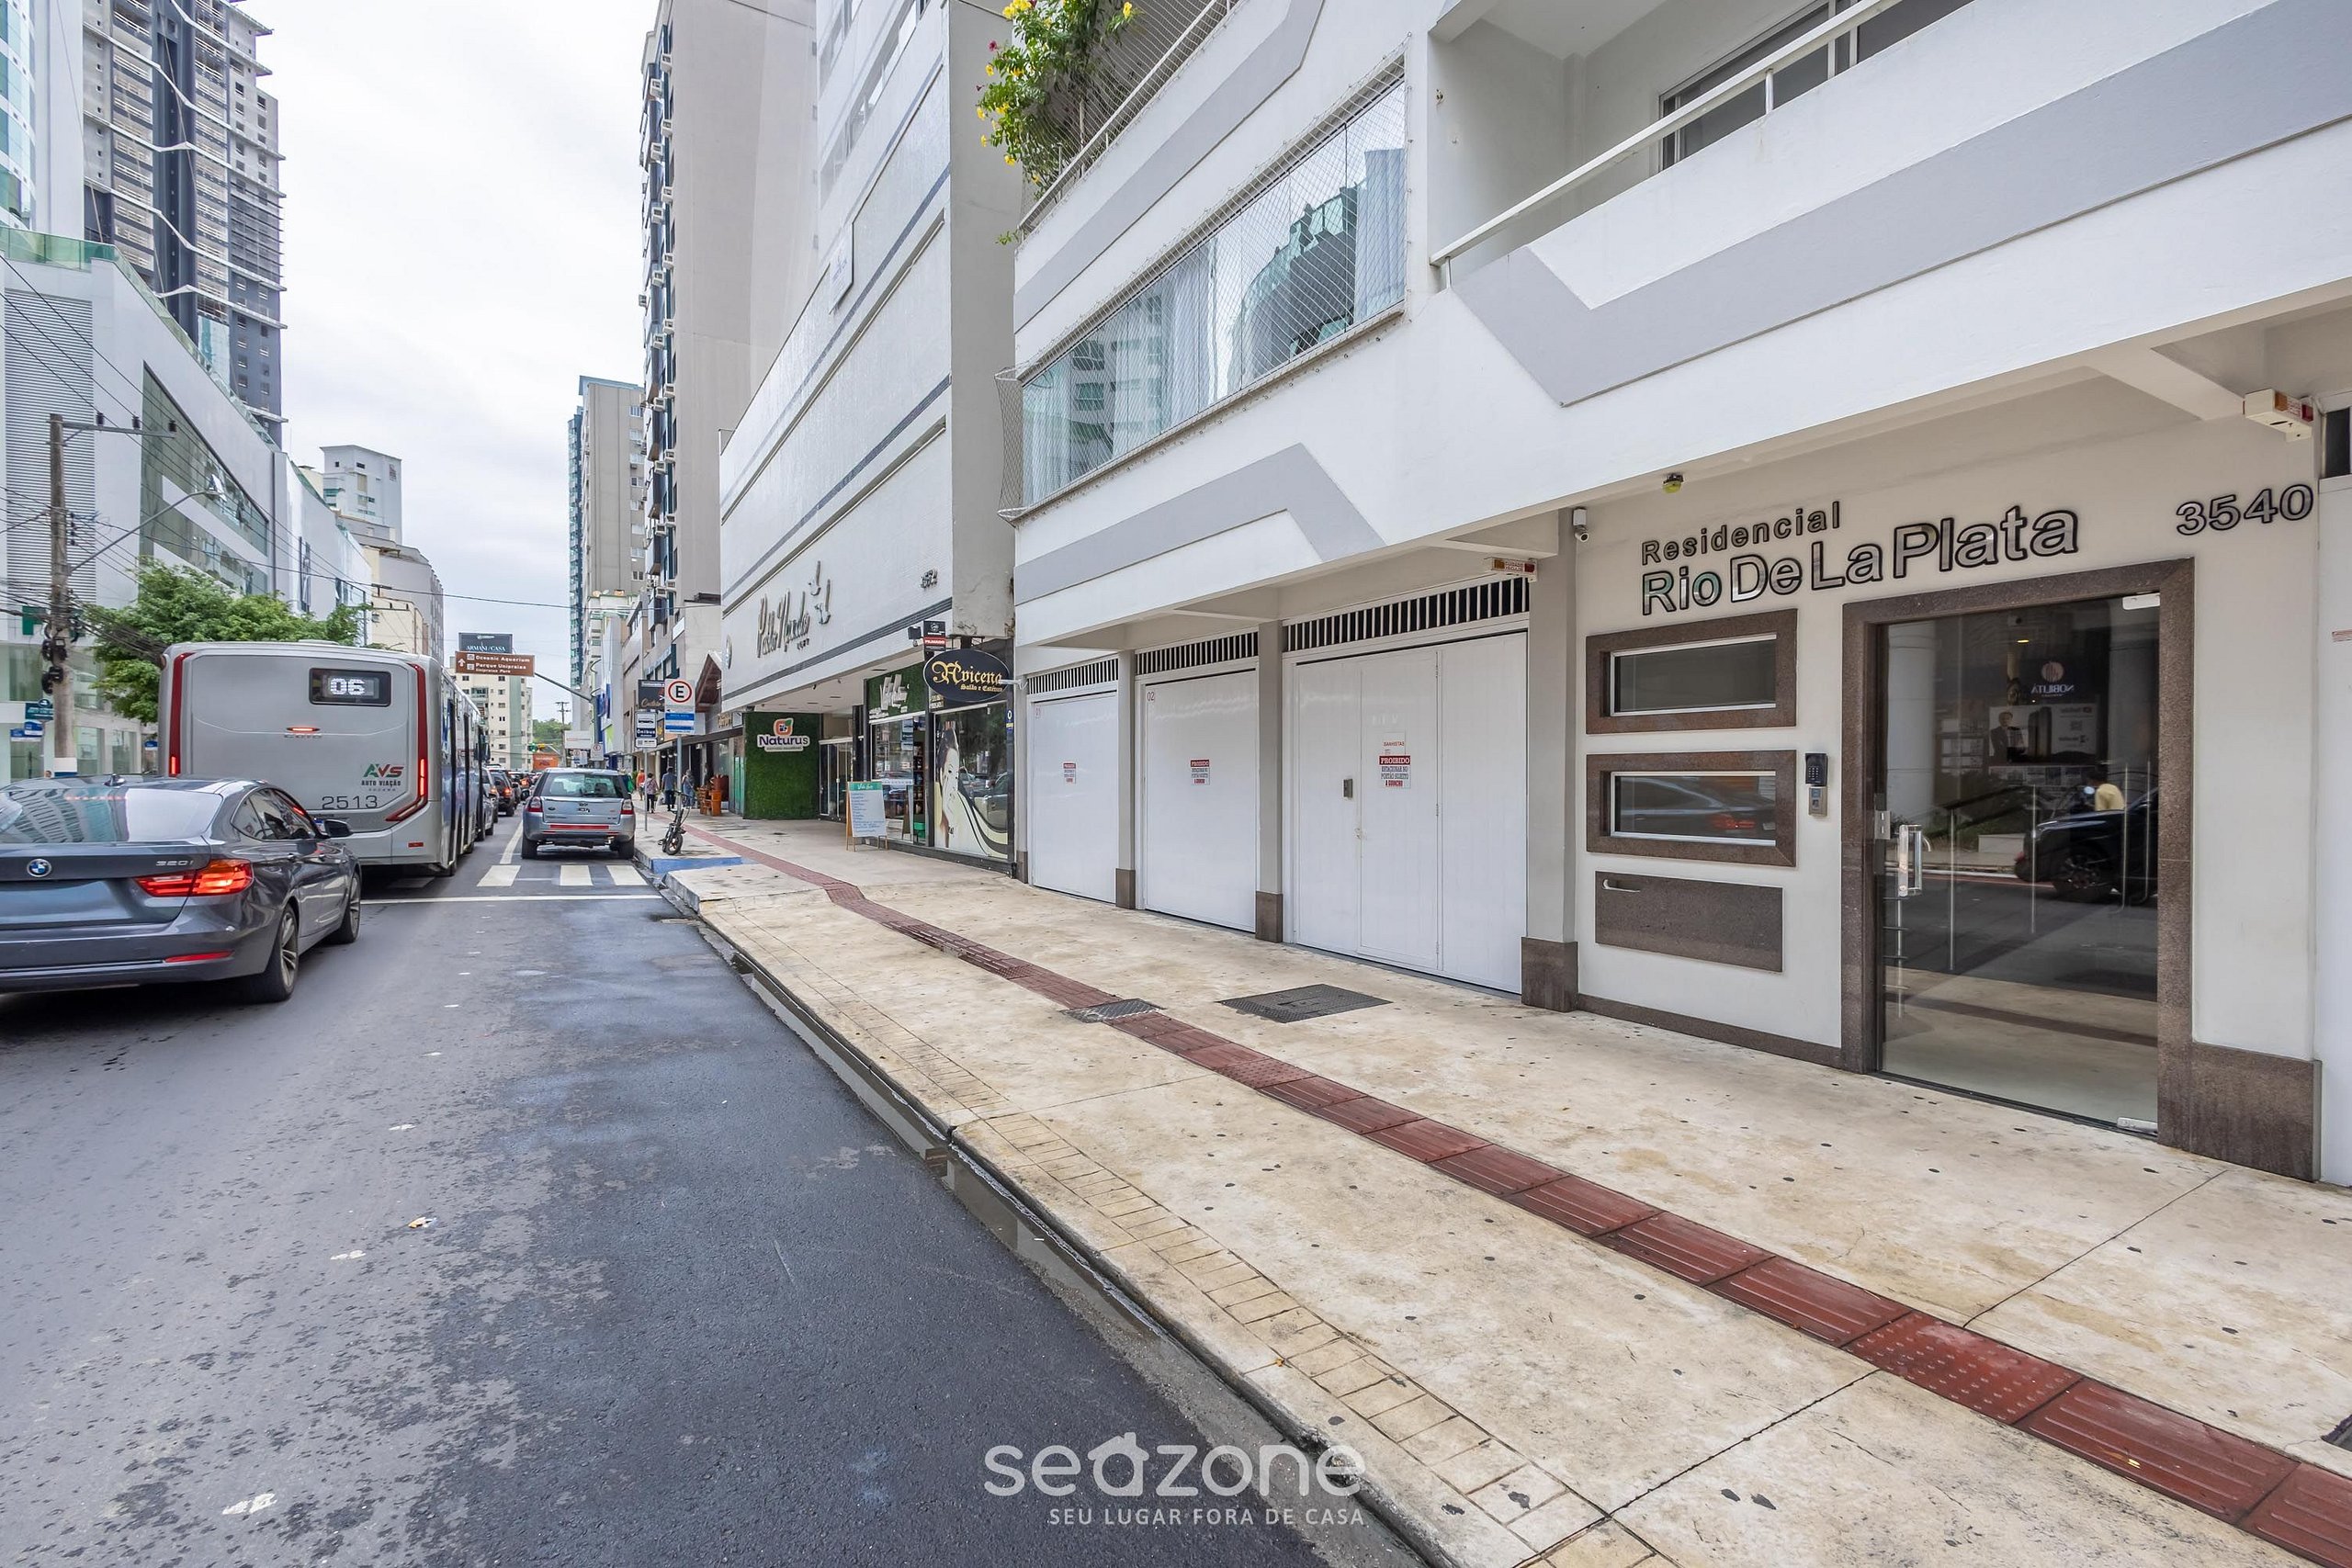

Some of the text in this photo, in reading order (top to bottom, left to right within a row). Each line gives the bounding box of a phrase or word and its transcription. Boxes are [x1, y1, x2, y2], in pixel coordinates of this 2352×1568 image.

[2176, 484, 2313, 536] 3540
[1641, 501, 1840, 566] Residencial
[1643, 505, 2078, 615] Rio De La Plata
[330, 678, 366, 695] 06
[675, 685, 684, 698] E
[1148, 692, 1155, 701] 02
[759, 736, 808, 745] Naturus
[363, 763, 404, 777] AVS
[379, 779, 401, 788] VIAÇÃO
[322, 795, 378, 809] 2513
[155, 859, 194, 867] 320i
